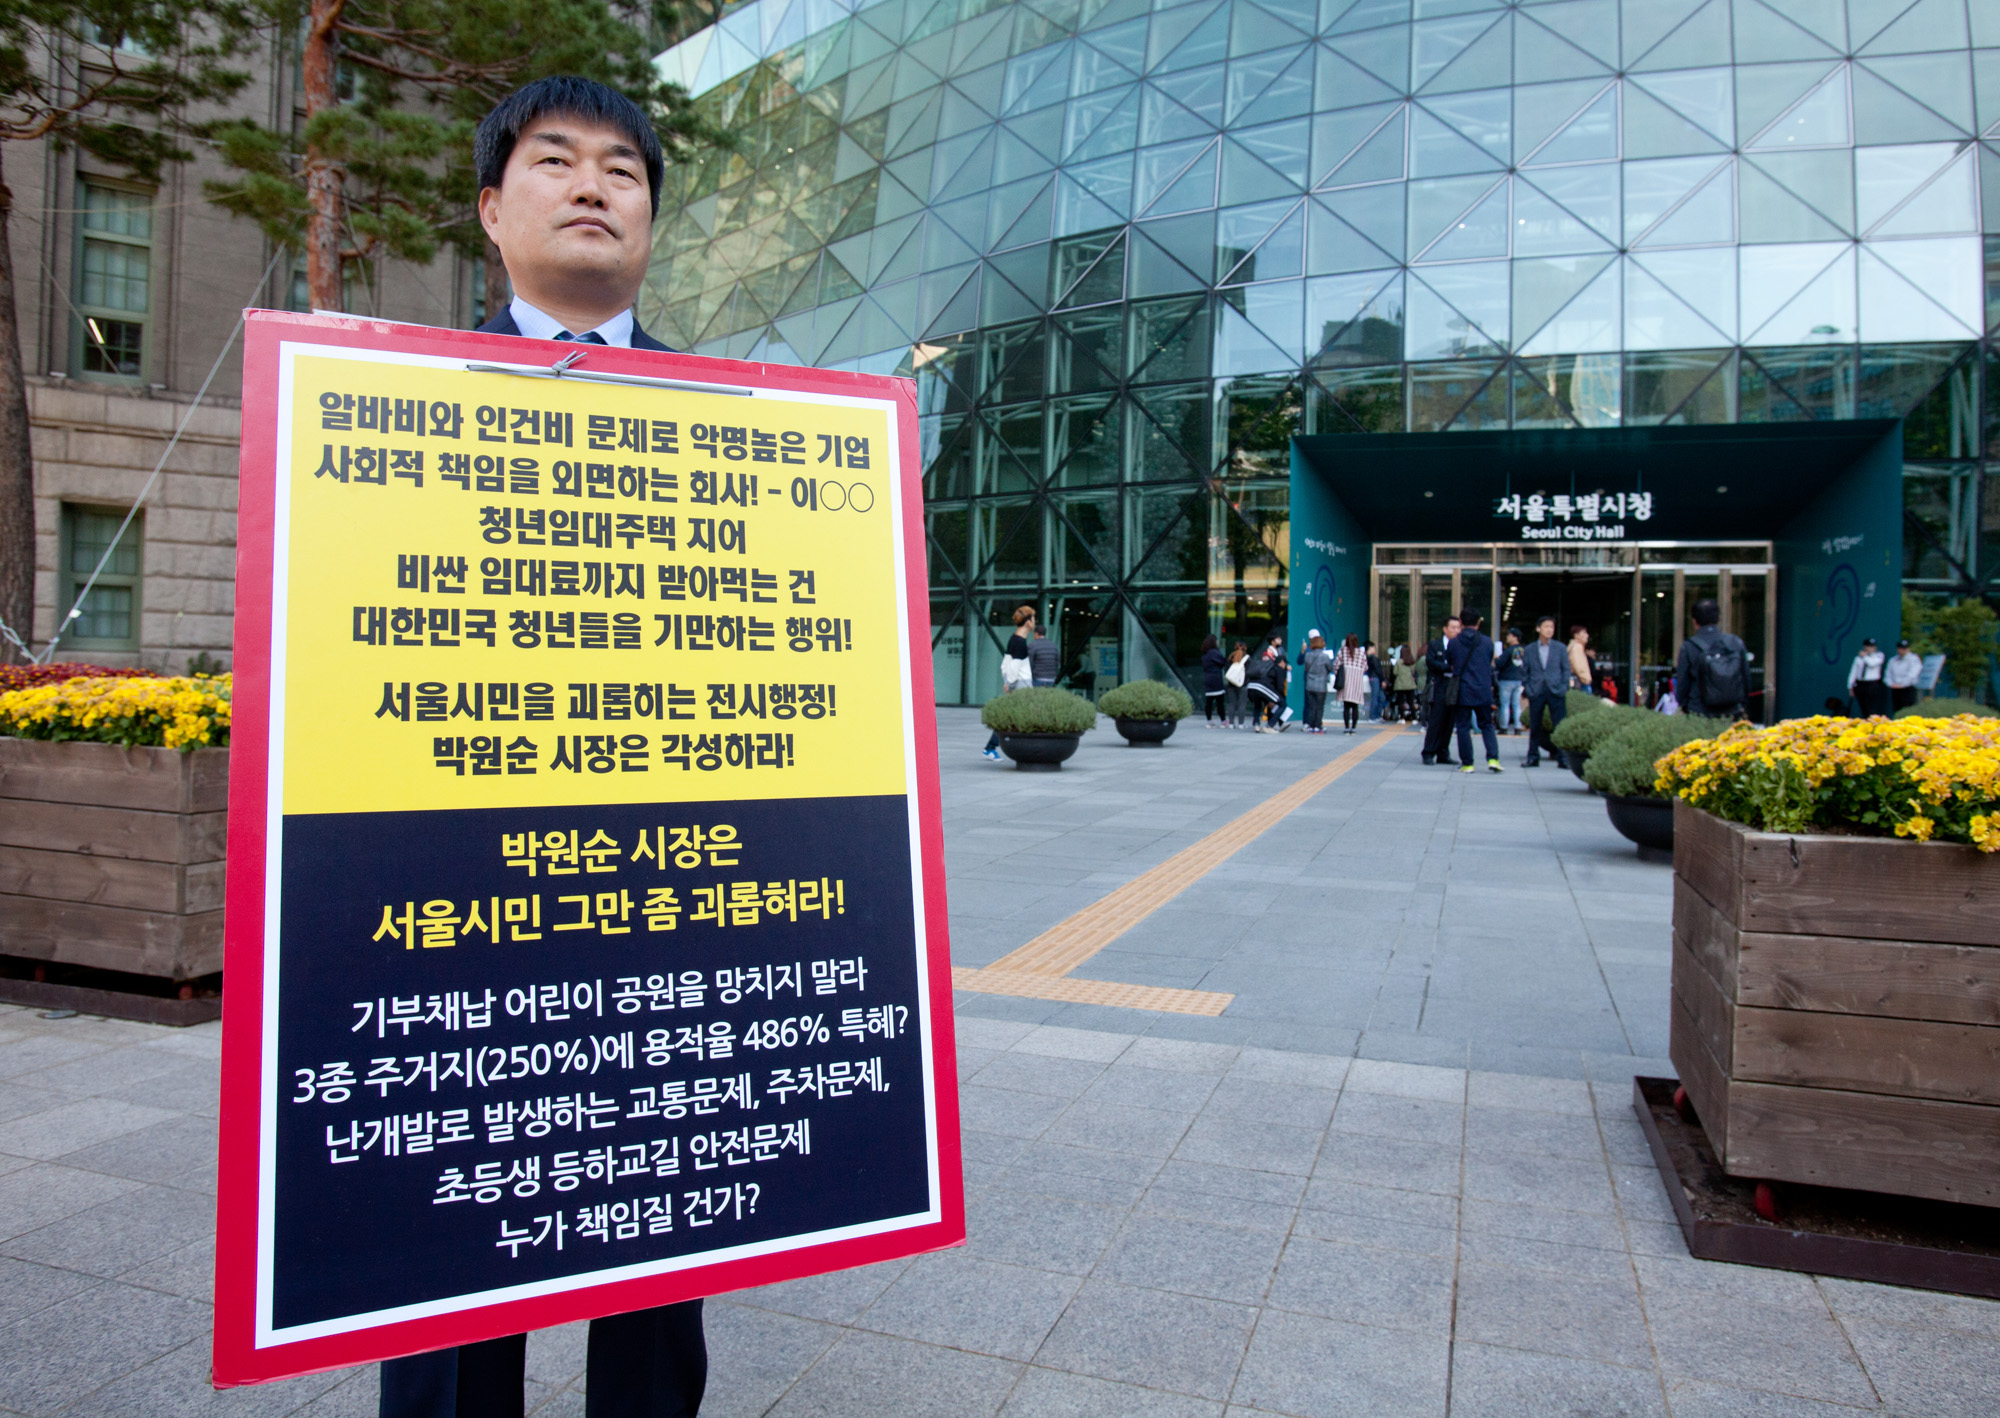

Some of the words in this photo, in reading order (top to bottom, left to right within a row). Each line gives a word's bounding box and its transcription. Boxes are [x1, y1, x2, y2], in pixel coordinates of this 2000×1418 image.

[320, 392, 463, 439] 알바비와
[476, 406, 572, 447] 인건비
[588, 415, 678, 454] 문제로
[691, 424, 805, 464] 악명높은
[817, 435, 869, 469] 기업
[314, 445, 423, 487] 사회적
[438, 453, 539, 494] 책임을
[553, 461, 678, 502] 외면하는
[691, 471, 757, 507] 회사!
[479, 506, 675, 551] 청년임대주택
[687, 518, 745, 554] 지어
[1496, 492, 1653, 522] 서울특별시청
[1521, 526, 1561, 539] Seoul
[1563, 526, 1593, 540] City
[1595, 525, 1625, 539] Hall
[398, 555, 468, 593] 비싼
[480, 557, 644, 599] 임대료까지
[658, 565, 777, 603] 받아먹는
[789, 570, 815, 604] 건
[353, 607, 496, 647] 대한민국
[509, 610, 641, 649] 청년들을
[655, 614, 774, 651] 기만하는
[786, 617, 851, 652] 행위!
[375, 682, 554, 721] 서울시민을
[568, 683, 695, 720] 괴롭히는
[707, 684, 836, 719] 전시행정!
[434, 736, 537, 776] 박원순
[550, 735, 649, 773] 시장은
[662, 733, 794, 771] 각성하라!
[502, 829, 621, 876] 박원순
[631, 825, 742, 870] 시장은
[372, 895, 541, 949] 서울시민
[553, 890, 634, 934] 그만
[642, 888, 681, 931] 좀
[690, 877, 844, 927] 괴롭혀라!
[352, 989, 496, 1038] 기부채납
[505, 979, 602, 1023] 어린이
[612, 971, 707, 1013] 공원을
[716, 962, 801, 1004] 망치지
[812, 957, 868, 995] 말라
[293, 1062, 356, 1103] 3종
[364, 1032, 633, 1096] 주거지(250%)에
[642, 1022, 736, 1066] 용적율
[743, 1014, 829, 1050] 486%
[838, 1005, 908, 1042] 특혜?
[327, 1109, 474, 1163] 난개발로
[484, 1092, 619, 1143] 발생하는
[626, 1073, 759, 1119] 교통문제,
[767, 1057, 889, 1104] 주차문제,
[433, 1156, 540, 1204] 초등생
[549, 1137, 679, 1191] 등하교길
[690, 1119, 810, 1170] 안전문제
[496, 1211, 568, 1258] 누가
[576, 1194, 672, 1242] 책임질
[684, 1183, 759, 1227] 건가?
